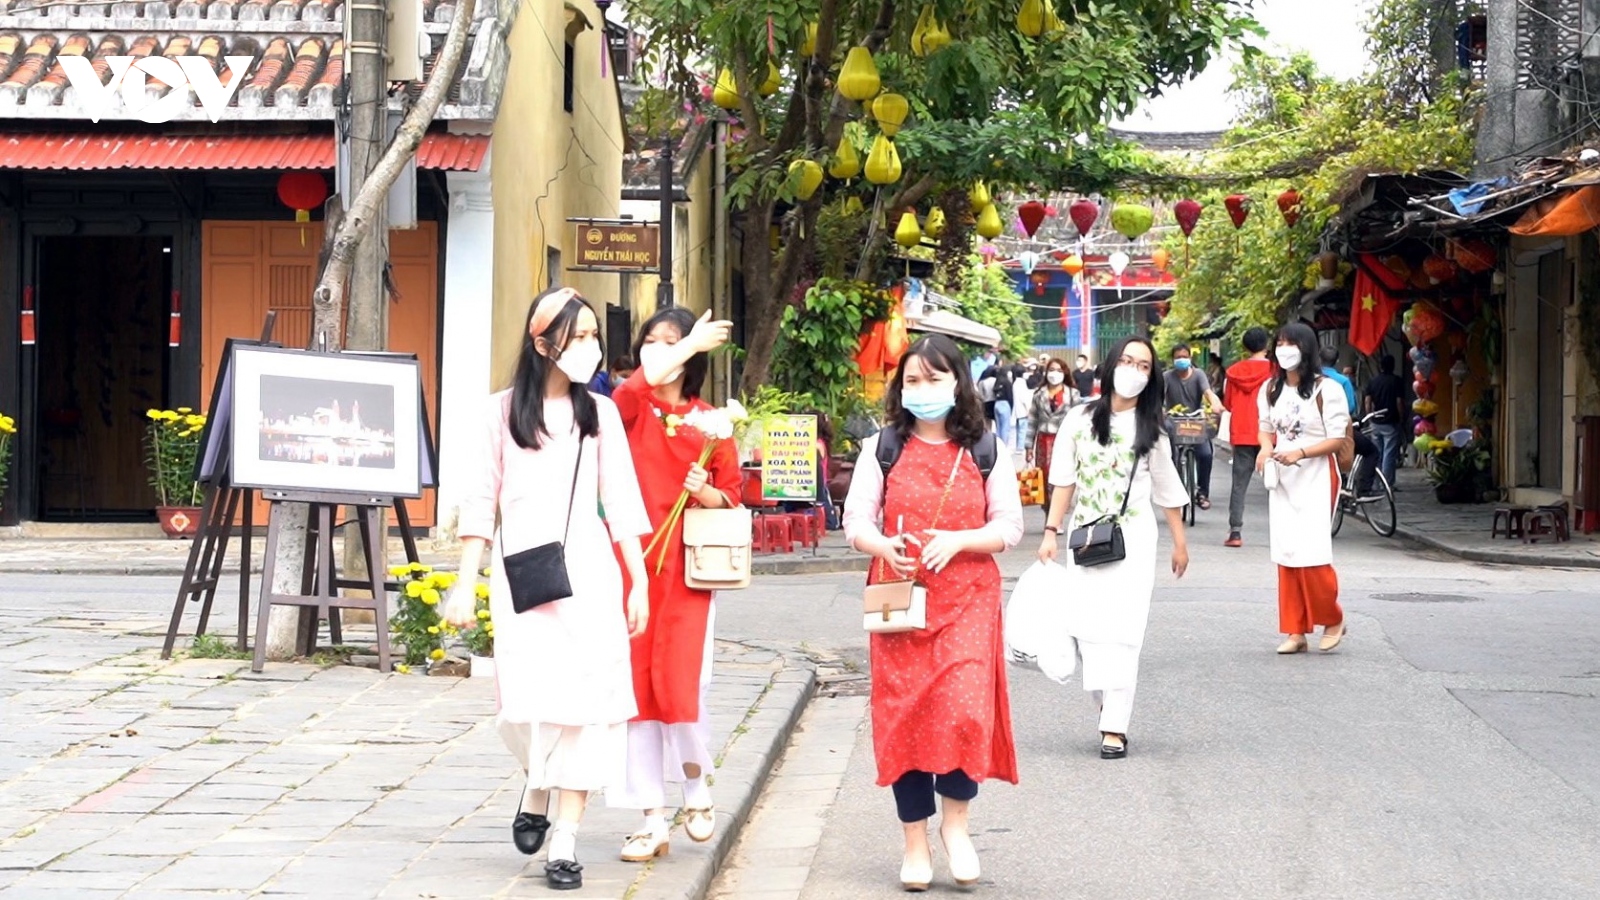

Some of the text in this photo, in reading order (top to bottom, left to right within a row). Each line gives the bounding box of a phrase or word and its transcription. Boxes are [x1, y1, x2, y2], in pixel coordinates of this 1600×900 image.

[584, 246, 650, 263] NGUYỄN THÁI HỌC
